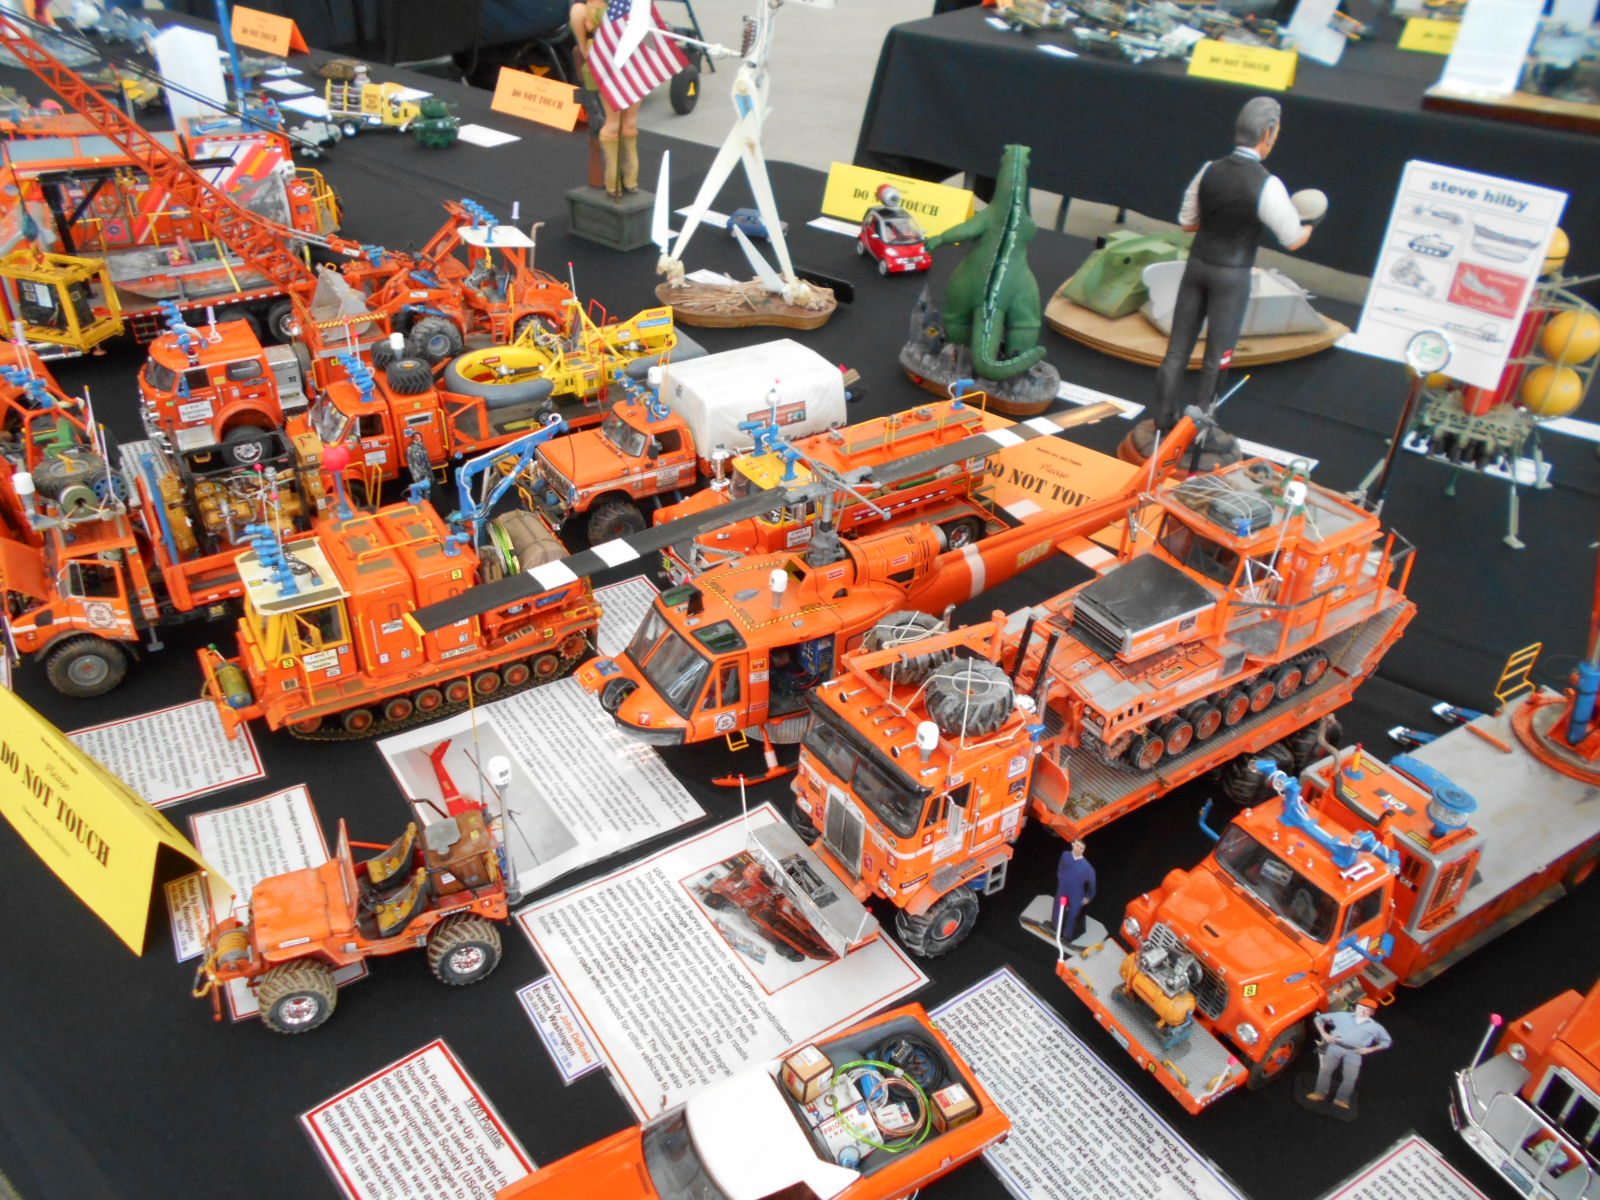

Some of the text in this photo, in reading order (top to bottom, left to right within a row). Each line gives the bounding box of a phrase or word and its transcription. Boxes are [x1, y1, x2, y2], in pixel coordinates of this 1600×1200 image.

[524, 92, 538, 102] NOT
[539, 95, 564, 110] TOUCH
[853, 187, 869, 199] DO
[900, 199, 939, 216] TOUCH
[1430, 179, 1530, 213] steve hilby
[1008, 468, 1048, 494] NOT
[1040, 463, 1070, 479] Please
[641, 714, 648, 723] 7
[0, 741, 20, 774] DO
[22, 763, 54, 808] NOT
[56, 797, 110, 869] TOUCH
[660, 879, 690, 911] Geological
[532, 987, 552, 1013] Everett,
[546, 1013, 577, 1056] Washington
[541, 983, 558, 1004] Model
[552, 1003, 564, 1014] by
[559, 1014, 575, 1032] John
[369, 1082, 380, 1092] in
[985, 987, 997, 996] of
[992, 995, 1008, 1007] the
[1004, 1006, 1039, 1039] American
[1035, 1038, 1073, 1072] LaFrance
[1066, 1072, 1100, 1102] pumper
[1096, 1100, 1116, 1118] was
[1113, 1116, 1164, 1164] demolished
[1157, 1162, 1174, 1176] by
[992, 982, 1023, 1010] vehicles
[1019, 1008, 1034, 1020] for
[1030, 1019, 1049, 1035] sale
[1050, 1041, 1061, 1049] a
[1058, 1048, 1081, 1067] used
[1076, 1066, 1100, 1087] truck
[1096, 1085, 1111, 1098] lot
[1107, 1096, 1120, 1107] in
[1114, 1105, 1159, 1146] Wyoming.
[1157, 1147, 1178, 1165] The
[1174, 1163, 1199, 1186] back
[1001, 978, 1019, 993] This
[1014, 992, 1036, 1010] truck
[1051, 1028, 1076, 1049] about
[1071, 1048, 1093, 1066] from
[1087, 1065, 1118, 1093] seeing
[1114, 1090, 1141, 1114] these
[1135, 1112, 1156, 1129] two
[1151, 1127, 1191, 1163] wrecked
[374, 1090, 389, 1106] the
[331, 1102, 357, 1133] always
[351, 1130, 371, 1154] need
[380, 1075, 467, 1199] deliver equipment packages to
[392, 1069, 414, 1095] States
[406, 1094, 443, 1140] Geological
[435, 1137, 465, 1172] Society
[398, 1127, 415, 1146] This
[403, 1062, 432, 1099] Houston,
[427, 1098, 449, 1123] Texas
[443, 1121, 455, 1132] is
[449, 1130, 470, 1154] used
[462, 1152, 478, 1167] by
[472, 1165, 488, 1182] the
[415, 1056, 432, 1075] This
[426, 1073, 452, 1105] Pontiac
[474, 1143, 502, 1177] located
[496, 1175, 509, 1187] in
[466, 1096, 505, 1149] 1970 Pontiac
[319, 1109, 354, 1155] equipment
[348, 1152, 360, 1164] in
[354, 1163, 369, 1181] use
[410, 1145, 426, 1165] was
[1412, 1149, 1432, 1167] This
[376, 1144, 392, 1162] The
[386, 1160, 414, 1196] seismic
[410, 1173, 427, 1192] was
[422, 1163, 434, 1175] in
[428, 1173, 444, 1191] the
[997, 1151, 1036, 1193] off easily.
[1386, 1167, 1409, 1188] yard
[1418, 1168, 1447, 1195] newly
